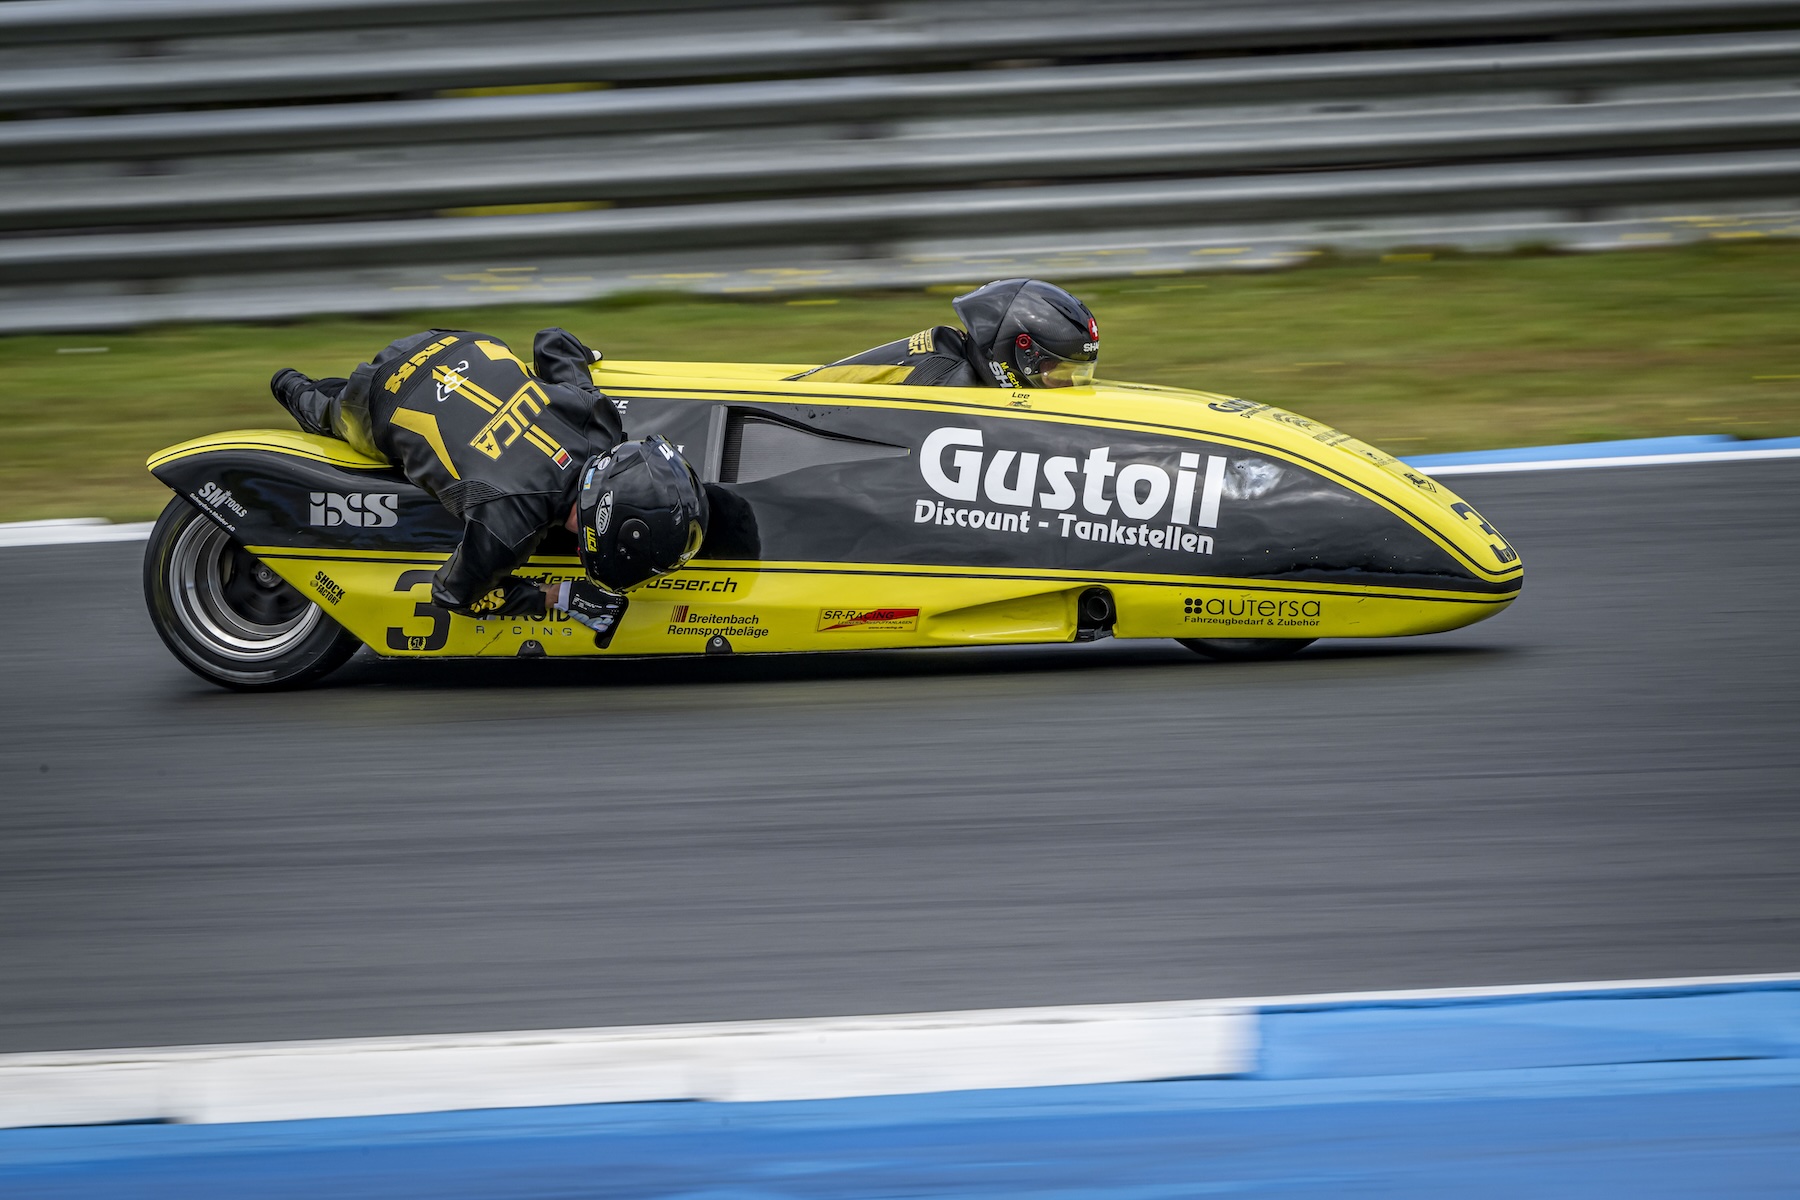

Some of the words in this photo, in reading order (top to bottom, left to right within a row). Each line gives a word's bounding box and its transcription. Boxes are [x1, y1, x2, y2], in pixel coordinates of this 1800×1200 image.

[469, 380, 551, 460] LUCA
[920, 427, 1227, 528] Gustoil
[198, 482, 228, 508] SM
[224, 497, 248, 517] TOOLS
[586, 526, 598, 552] LUCA
[914, 499, 1031, 533] Discount
[1057, 513, 1215, 555] Tankstellen
[1450, 502, 1517, 563] 3
[315, 571, 346, 599] SHOCK
[316, 584, 340, 606] FACTORY
[386, 570, 451, 650] 3
[688, 613, 759, 624] Breitenbach
[823, 610, 894, 620] SR-RACING
[1184, 616, 1264, 626] Fahrzeugbedarf
[1277, 618, 1320, 627] Zubehör
[476, 626, 572, 636] RCING
[667, 625, 769, 638] Rennsportbeläge
